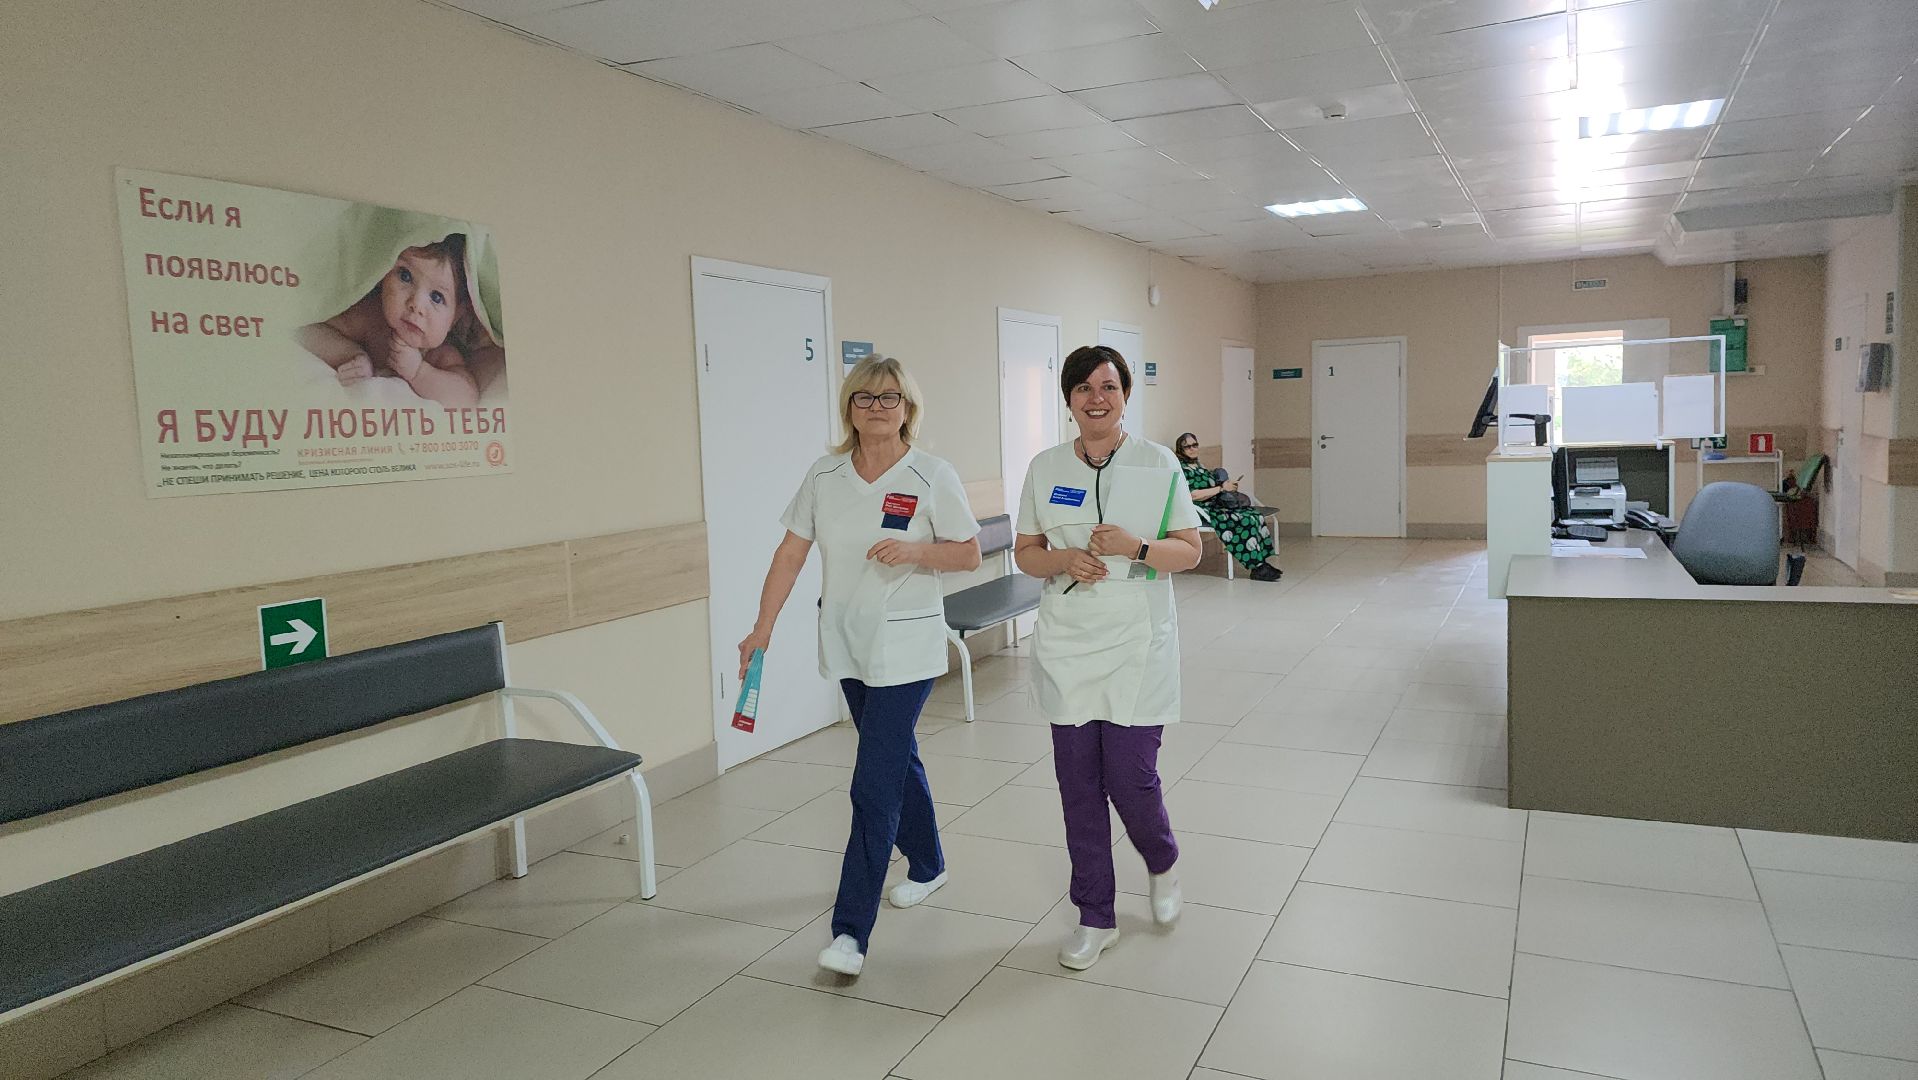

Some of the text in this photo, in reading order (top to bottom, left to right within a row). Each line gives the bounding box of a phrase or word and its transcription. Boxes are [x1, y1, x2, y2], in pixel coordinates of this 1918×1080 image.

[139, 187, 242, 228] Если я
[145, 253, 300, 288] появлюсь
[151, 310, 264, 338] на свет
[805, 338, 814, 361] 5
[1328, 366, 1335, 376] 1
[157, 407, 506, 449] Я БУДУ ЛЮБИТЬ ТЕБЯ
[298, 446, 357, 457] КРИЗИСНАЯ
[360, 445, 393, 455] ЛИНИЯ
[176, 475, 209, 486] СПЕШИ
[210, 472, 265, 484] ПРИНИМАТЬ
[309, 467, 329, 478] ЦЕНА
[330, 466, 368, 477] КОТОРОГО
[368, 465, 391, 475] СТОЛЬ
[391, 464, 417, 473] ВЕЛИКА
